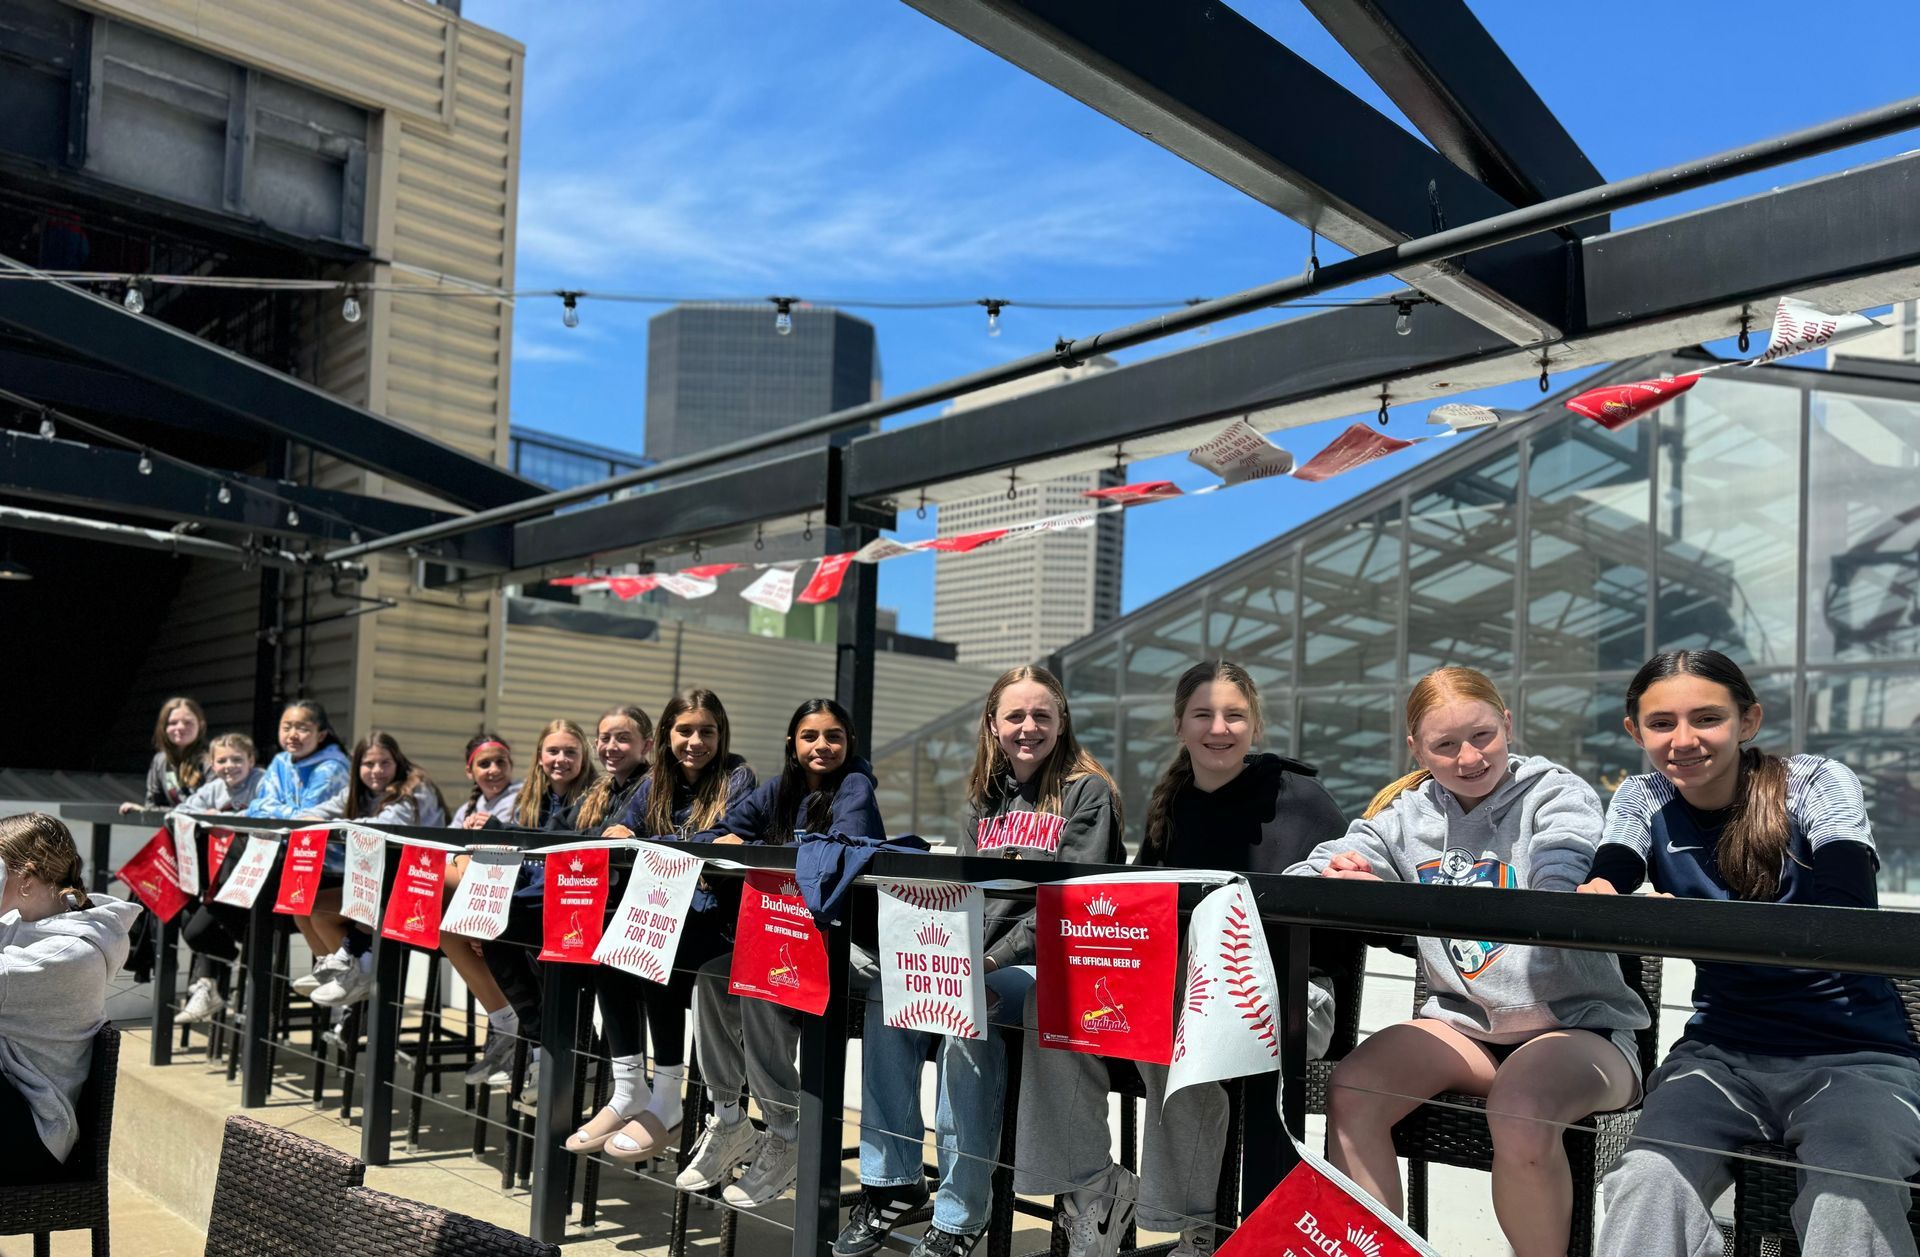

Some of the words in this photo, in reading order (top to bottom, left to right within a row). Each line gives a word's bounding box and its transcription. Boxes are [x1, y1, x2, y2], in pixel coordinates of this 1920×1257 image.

[1801, 321, 1819, 344] FOR
[1816, 320, 1837, 345] THIS
[469, 883, 489, 897] THIS
[557, 874, 599, 886] Budweiser
[468, 898, 487, 911] FOR
[487, 900, 503, 914] YOU
[627, 906, 650, 925] THIS
[649, 913, 677, 934] BUD'S
[1060, 919, 1149, 940] Budweiser
[624, 925, 646, 943] FOR
[646, 930, 667, 949] YOU
[896, 951, 928, 972] THIS
[931, 954, 971, 977] BUD'S
[1069, 956, 1082, 965] THE
[1082, 957, 1112, 967] OFFICIAL
[1113, 958, 1131, 968] BEER
[1131, 959, 1141, 969] OF
[905, 974, 931, 994] FOR
[936, 976, 963, 998] YOU
